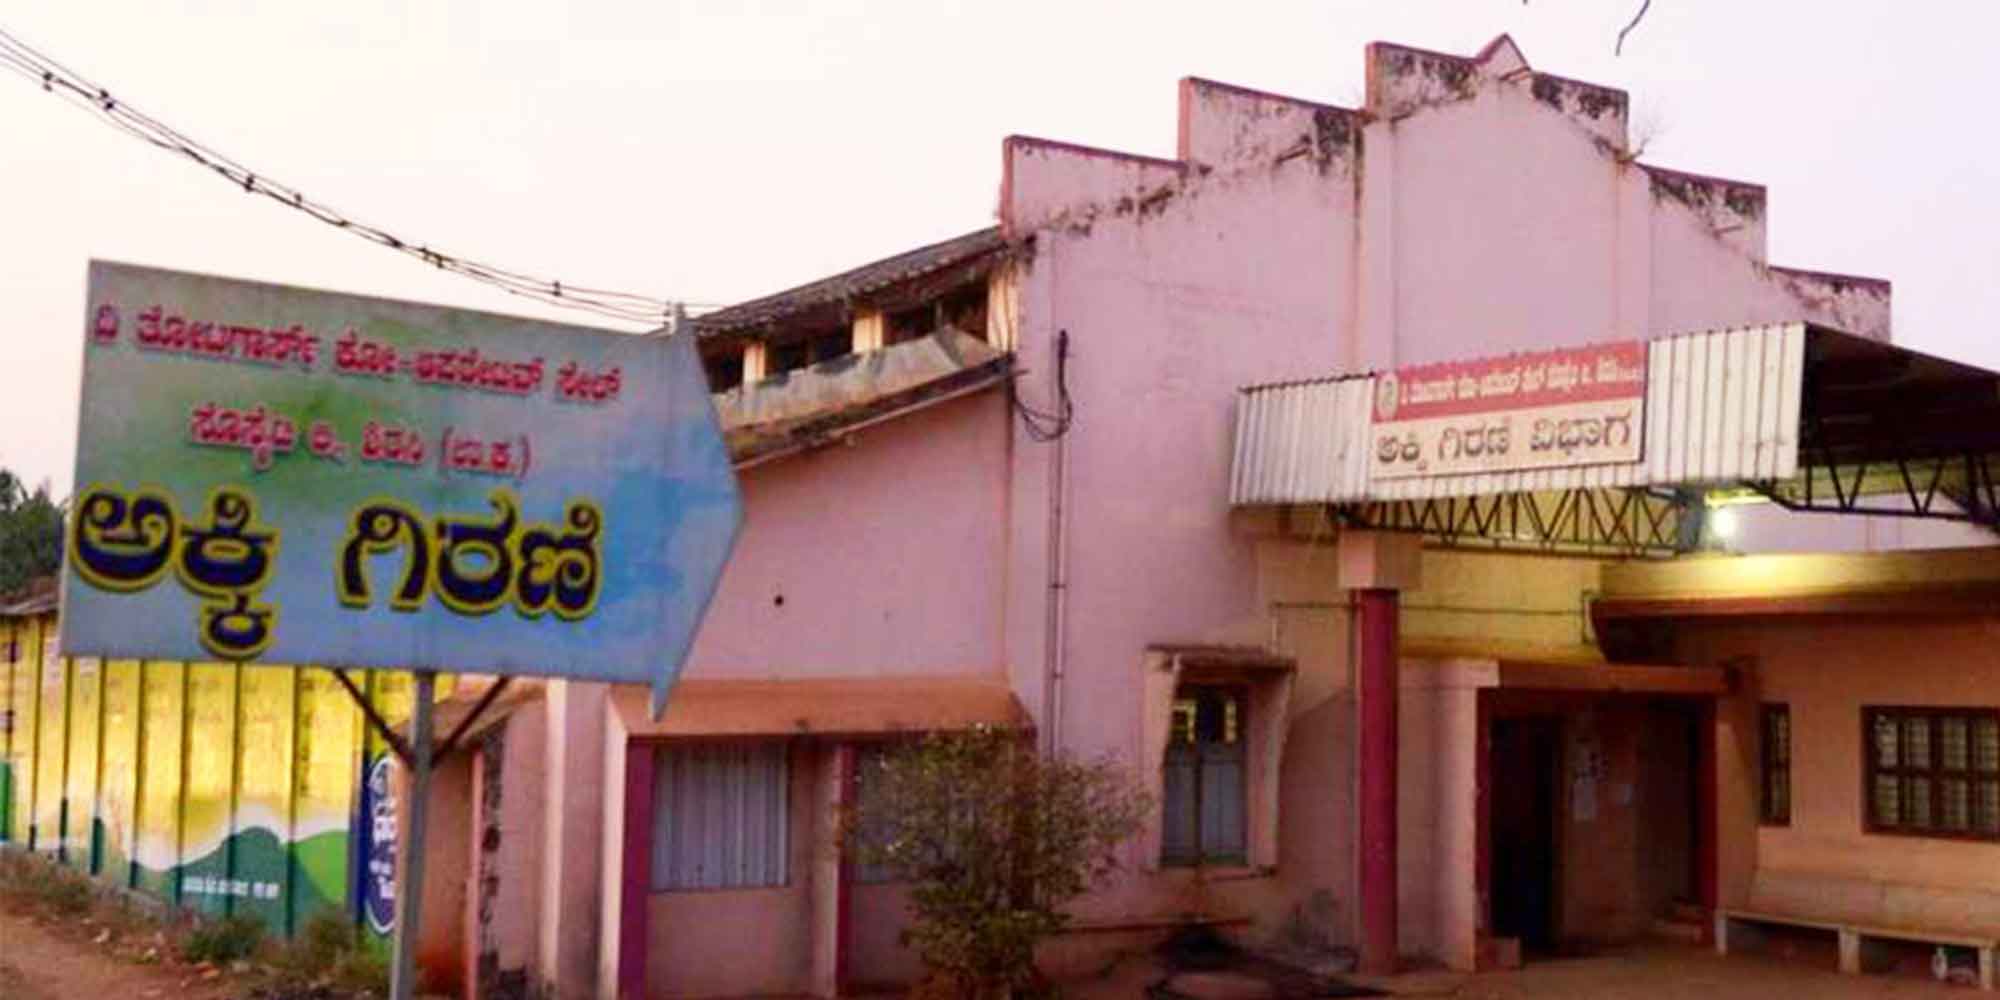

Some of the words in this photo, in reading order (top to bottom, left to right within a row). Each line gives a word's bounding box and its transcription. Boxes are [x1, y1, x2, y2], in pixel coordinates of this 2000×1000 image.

[93, 305, 119, 343] ದಿ
[1438, 416, 1511, 460] ಗಿರಣಿ
[1530, 409, 1632, 456] ವಿಭಾಗ
[70, 486, 278, 659] ಅಕ್ಕಿ
[337, 488, 600, 621] ಗಿರಣಿ
